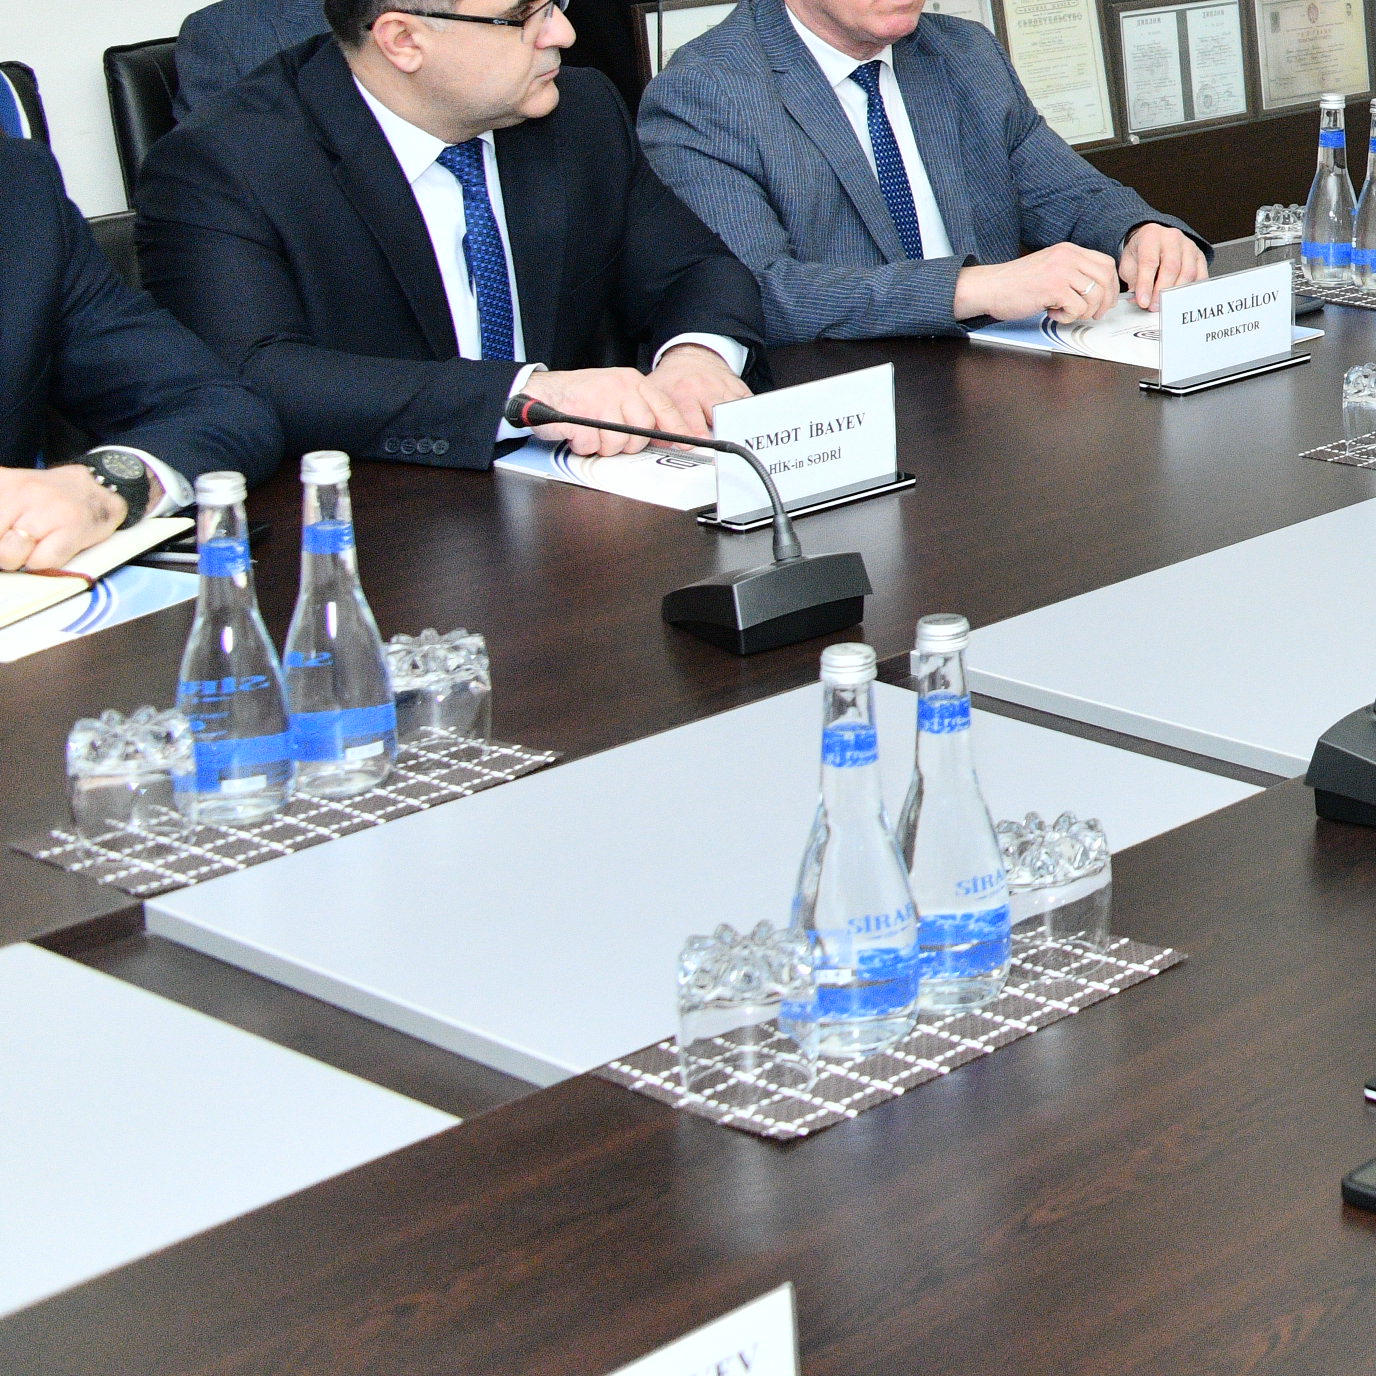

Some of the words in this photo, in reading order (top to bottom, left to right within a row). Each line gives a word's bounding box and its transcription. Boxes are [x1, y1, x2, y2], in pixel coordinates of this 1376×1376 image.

[1180, 303, 1224, 325] ELMAR
[1227, 290, 1280, 314] XƏLİLOV
[1205, 320, 1261, 343] PROREKTOR
[744, 426, 802, 453] NEMƏT
[809, 412, 866, 439] İBAYEV
[807, 446, 842, 467] SƏDRİ
